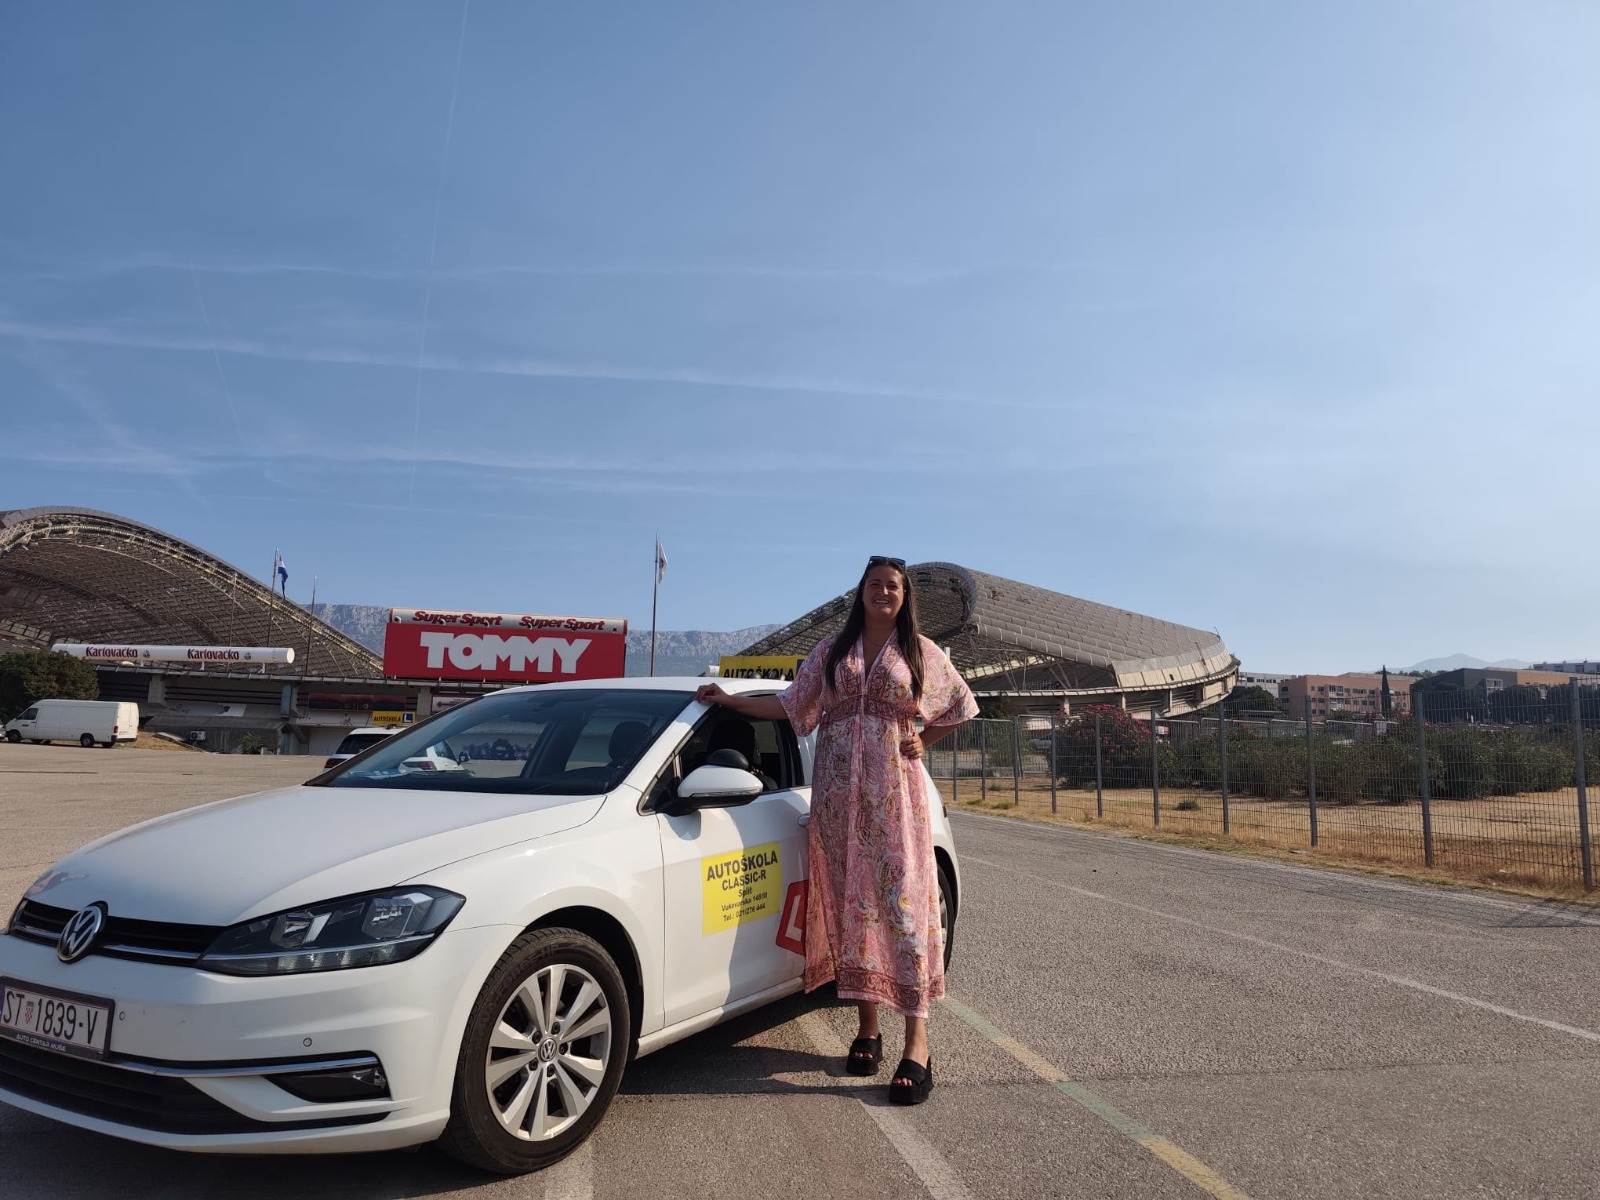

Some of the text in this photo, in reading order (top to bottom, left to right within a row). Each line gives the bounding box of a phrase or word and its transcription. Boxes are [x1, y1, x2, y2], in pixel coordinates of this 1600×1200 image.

[420, 631, 592, 674] TOMMY
[707, 850, 778, 881] AUTOŠKOLA
[722, 869, 767, 891] CLASSIC-R
[738, 887, 753, 898] Split
[3, 991, 25, 1026] ST
